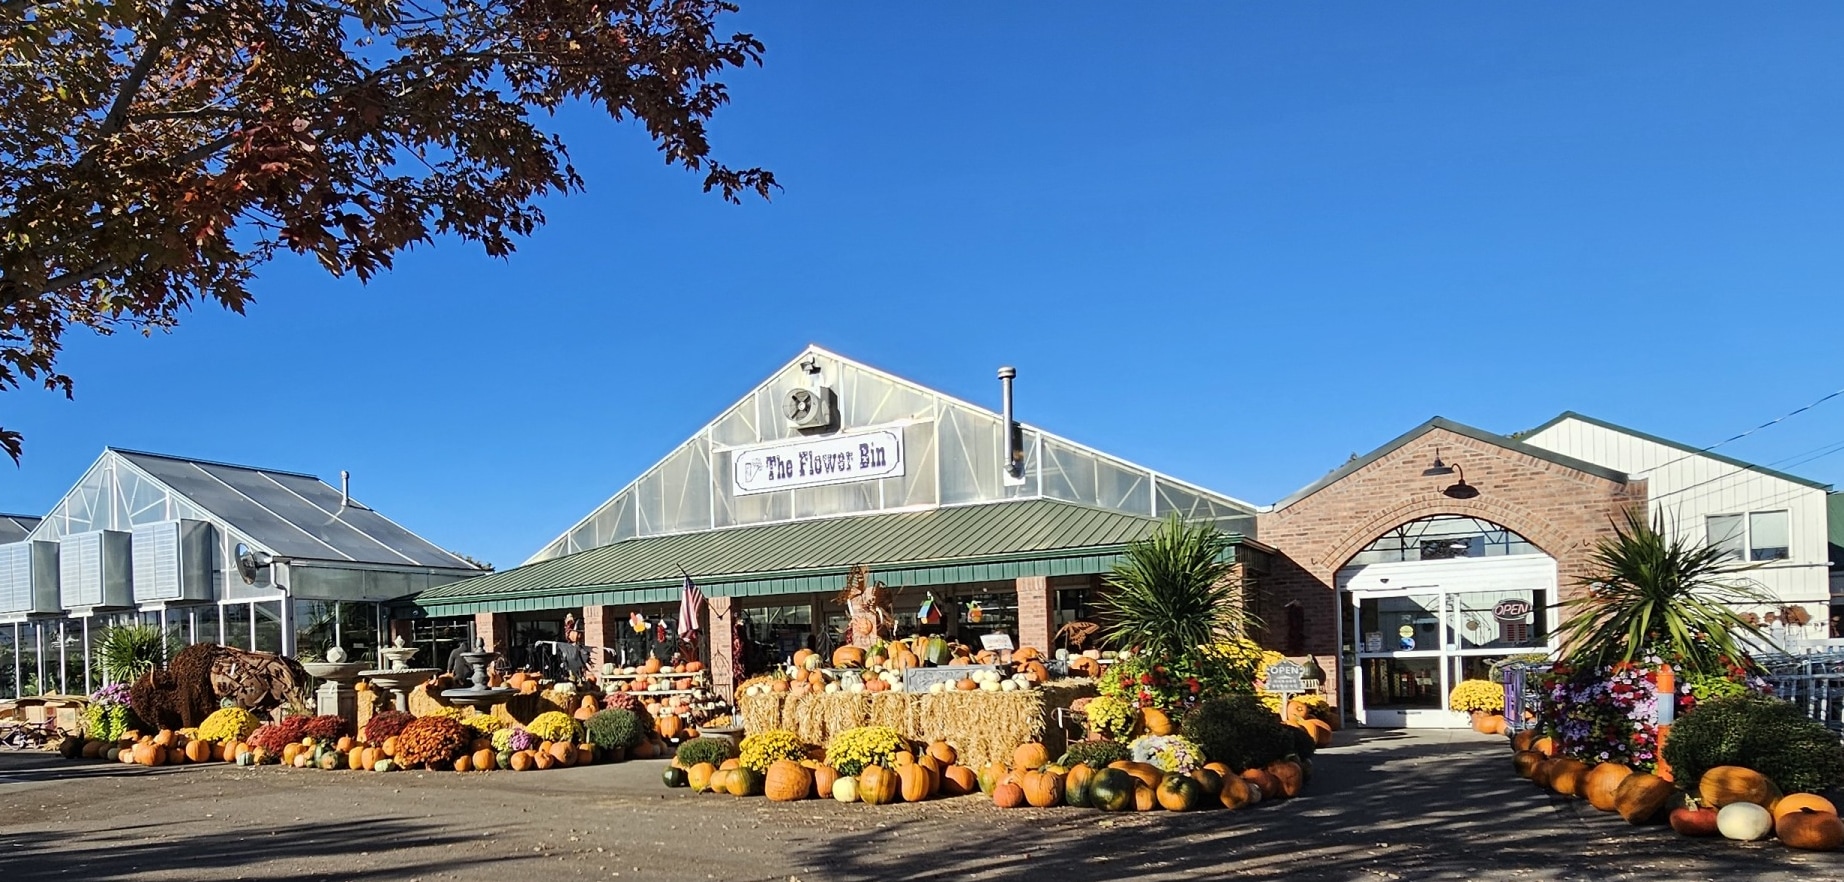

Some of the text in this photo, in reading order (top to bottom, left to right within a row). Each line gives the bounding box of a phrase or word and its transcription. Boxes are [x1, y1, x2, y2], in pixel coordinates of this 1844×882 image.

[766, 442, 886, 480] The Flower Bin
[1494, 603, 1529, 615] OPEN
[1270, 666, 1299, 675] OPEN
